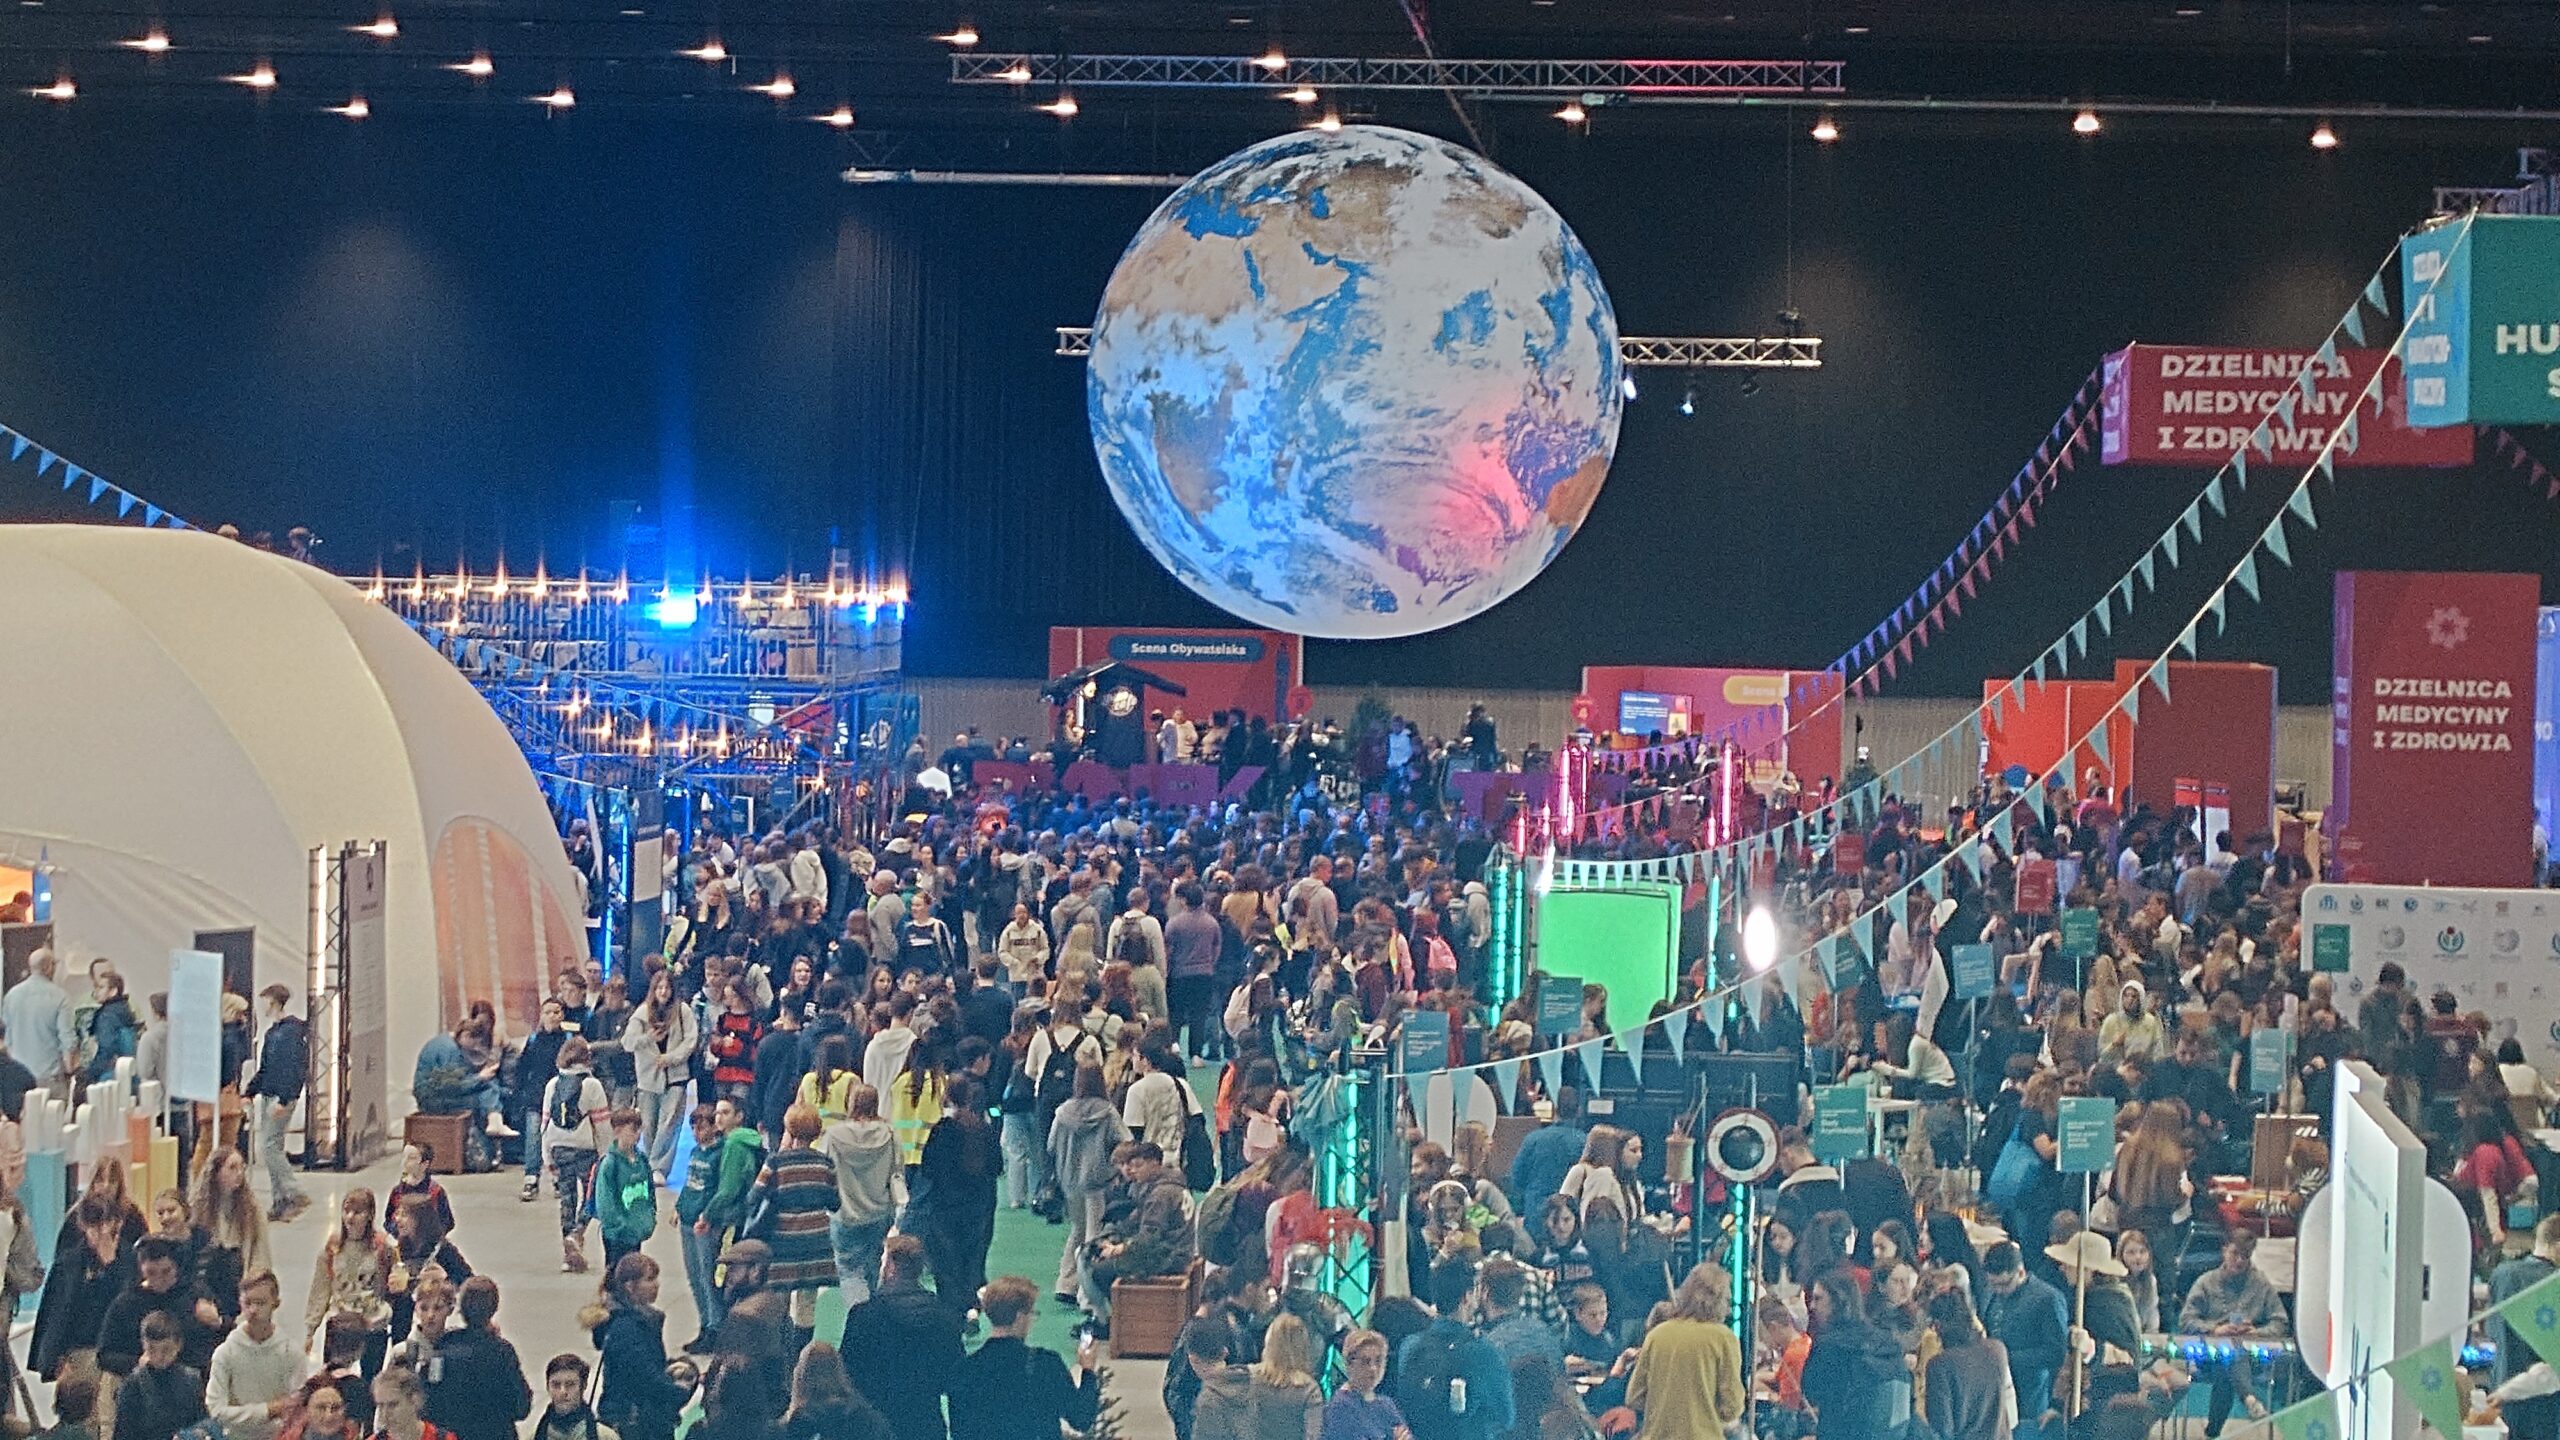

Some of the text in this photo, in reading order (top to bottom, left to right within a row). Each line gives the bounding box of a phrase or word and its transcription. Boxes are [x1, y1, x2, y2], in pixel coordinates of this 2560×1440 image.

[2160, 354, 2352, 378] DZIELNICA
[2158, 426, 2175, 450] I
[1131, 643, 1247, 656] Scena Obywatelska
[2375, 678, 2512, 698] DZIELNICA
[2376, 704, 2509, 724] MEDYCYNY
[2373, 731, 2512, 751] I ZDROWIA
